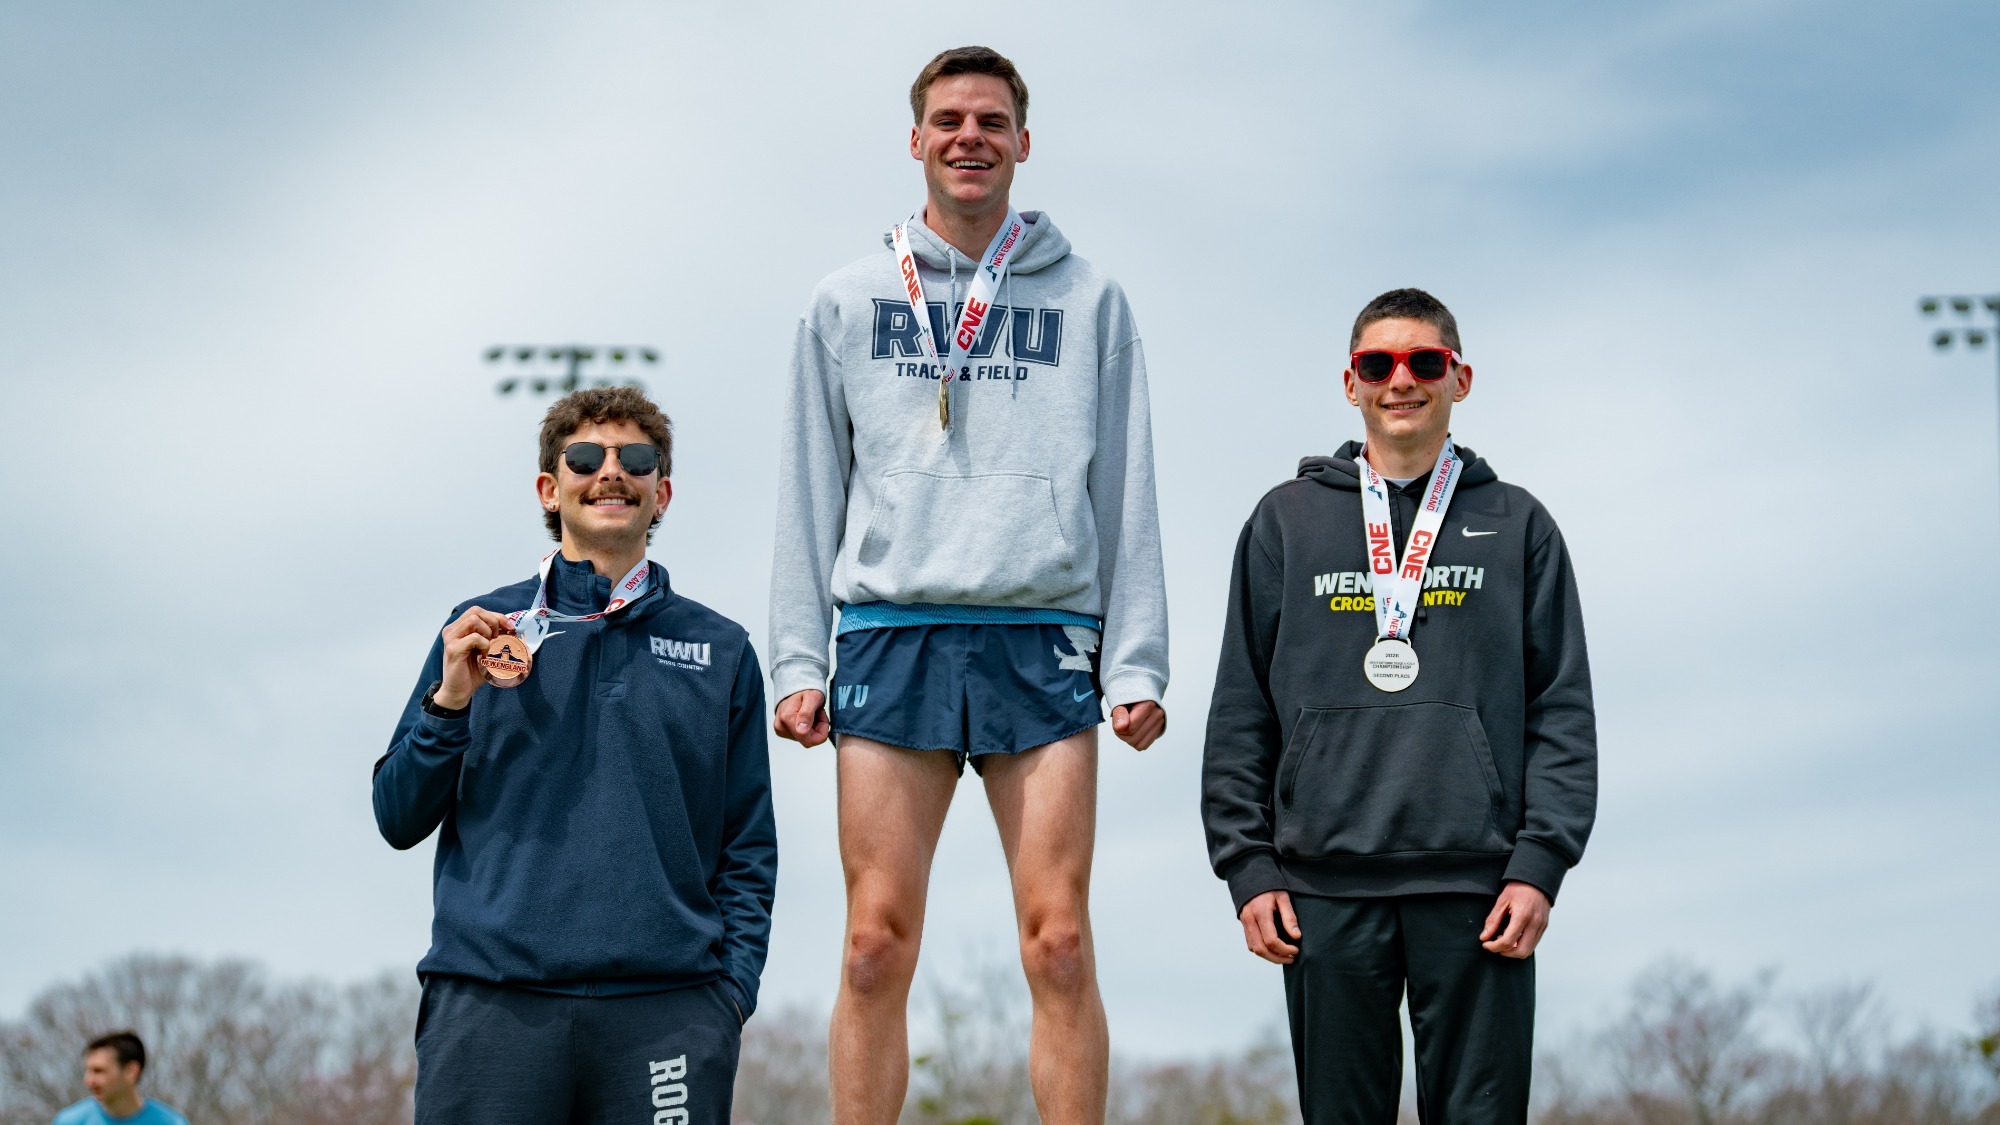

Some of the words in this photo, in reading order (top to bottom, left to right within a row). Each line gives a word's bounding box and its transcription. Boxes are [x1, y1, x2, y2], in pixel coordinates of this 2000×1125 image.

[993, 251, 1006, 267] NEW
[1001, 223, 1021, 253] ENGLAND
[901, 254, 921, 306] CNE
[871, 298, 1064, 368] RWU
[957, 296, 988, 351] CNE
[895, 363, 946, 380] TRAC
[959, 366, 971, 381] &
[977, 365, 1028, 381] FIELD
[1440, 457, 1453, 477] NEW
[1426, 475, 1446, 512] ENGLAND
[1368, 522, 1393, 575] CNE
[1401, 530, 1433, 582] CNE
[1314, 565, 1485, 597] WENRTH
[1330, 596, 1375, 611] CROS
[1423, 590, 1467, 607] NTRY
[1388, 618, 1400, 638] NEW
[481, 659, 497, 668] NEW
[496, 662, 527, 673] ENGLAND
[649, 634, 711, 666] RWU
[677, 662, 704, 671] COUNTRY
[649, 1054, 689, 1125] ROG
